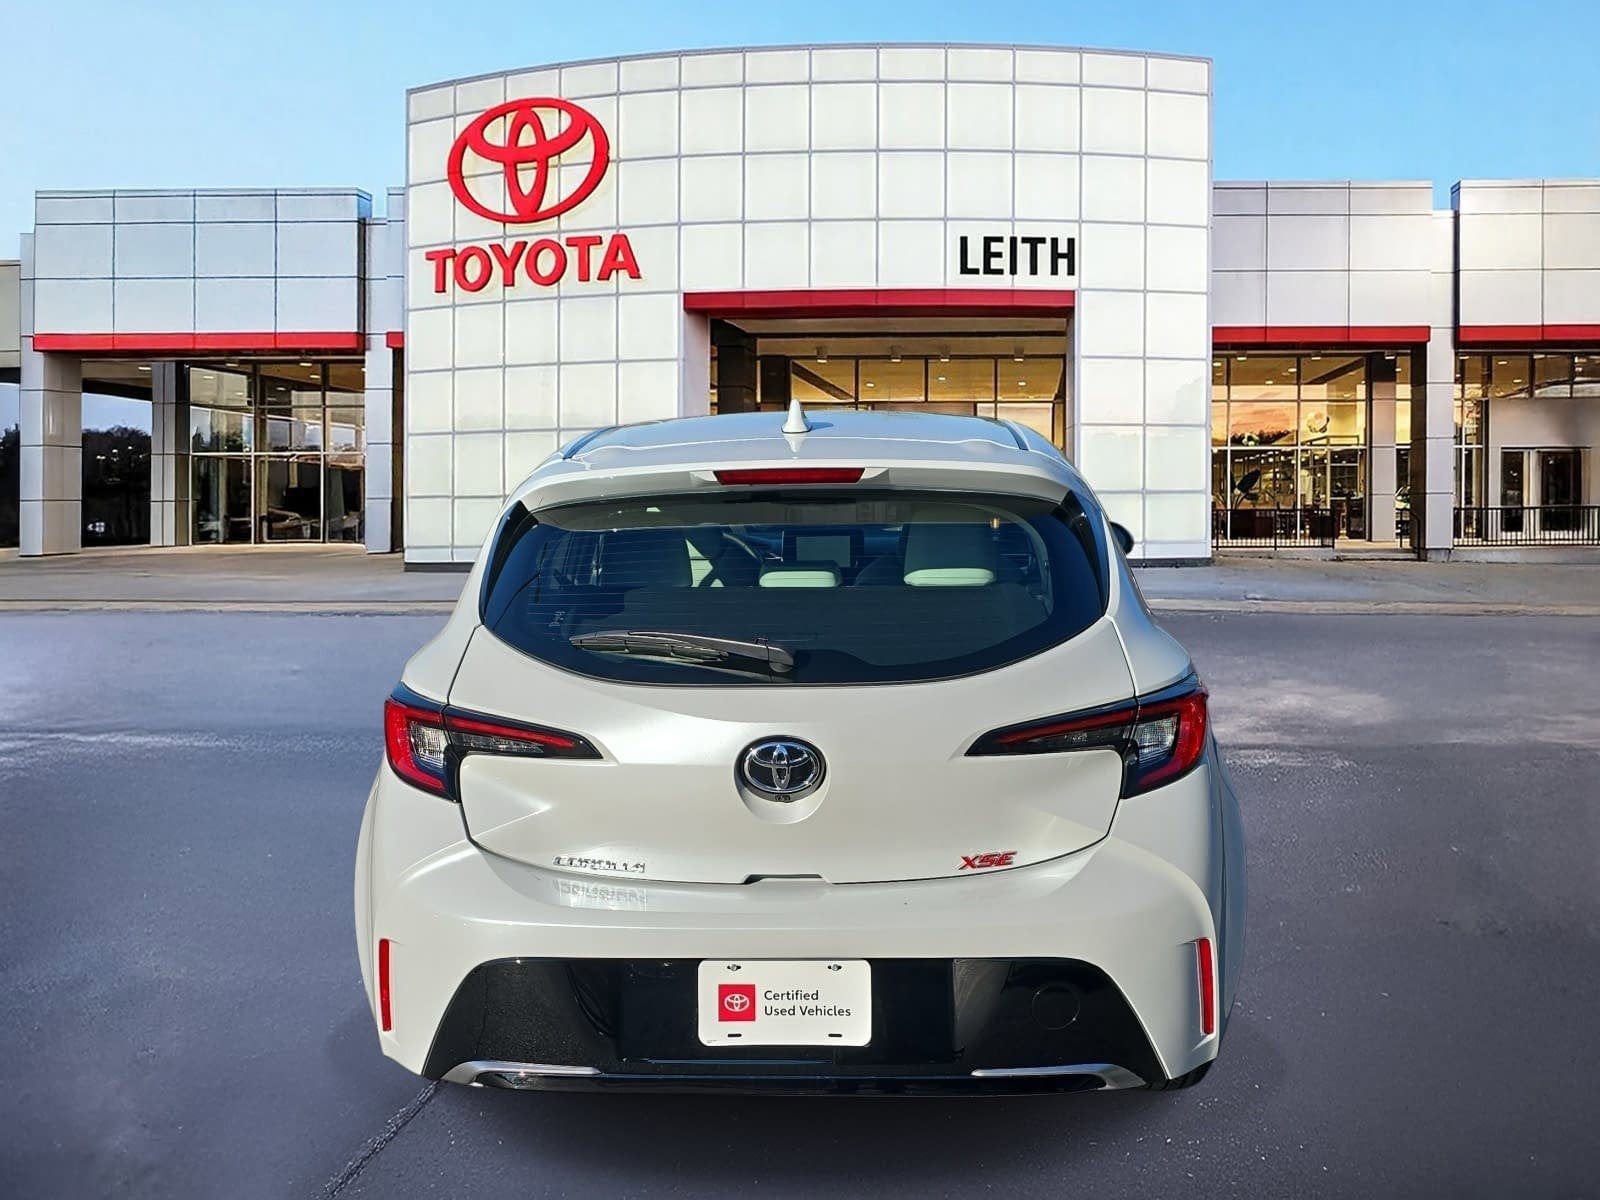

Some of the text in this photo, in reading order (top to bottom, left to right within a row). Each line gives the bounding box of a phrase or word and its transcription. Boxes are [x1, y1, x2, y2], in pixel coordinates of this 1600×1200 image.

[425, 233, 643, 294] TOYOTA
[959, 235, 1076, 277] LEITH
[958, 850, 1018, 871] XSE
[763, 989, 819, 1001] Certified
[763, 1005, 852, 1017] Used Vehicles
